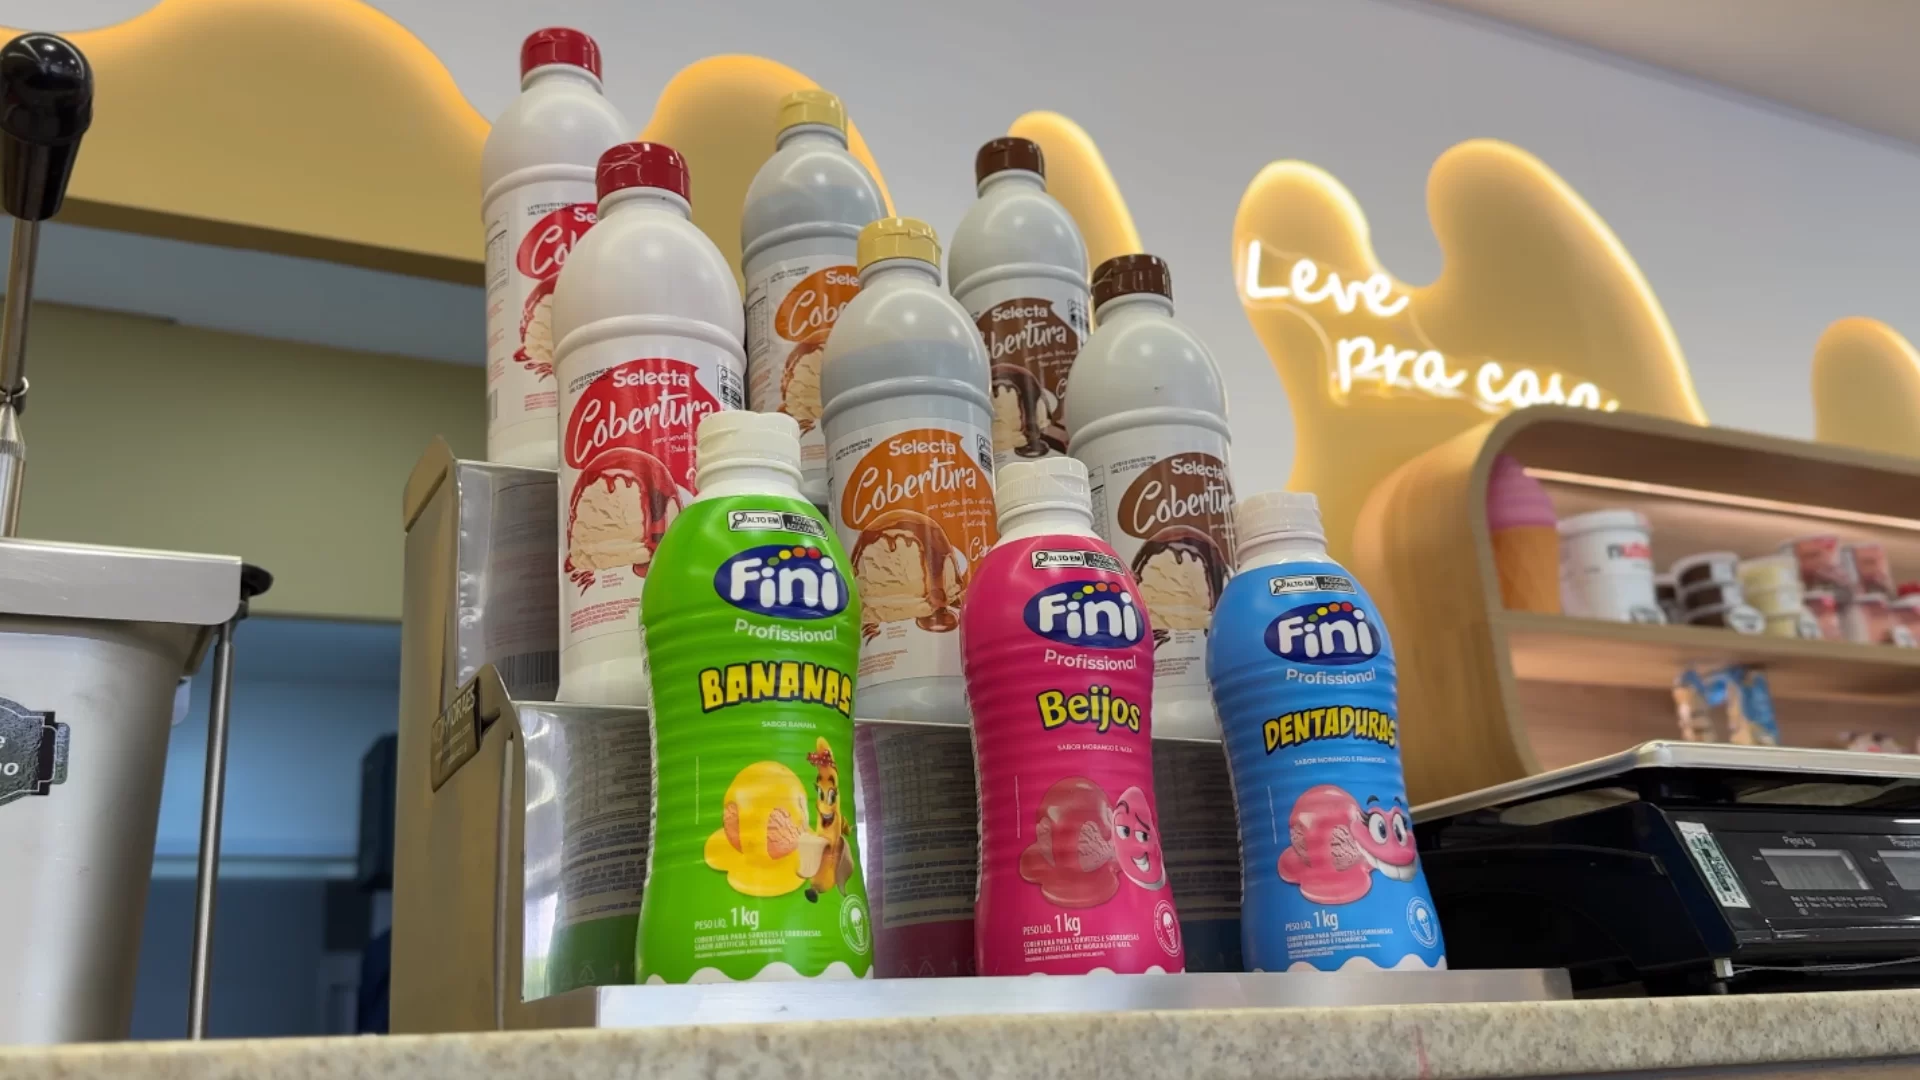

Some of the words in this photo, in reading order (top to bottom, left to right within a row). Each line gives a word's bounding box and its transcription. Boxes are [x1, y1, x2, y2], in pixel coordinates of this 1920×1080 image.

[825, 270, 859, 287] Sele
[1246, 239, 1410, 317] Leve
[991, 304, 1048, 322] Selecta
[980, 319, 1067, 359] bertura
[1336, 335, 1467, 393] pra
[612, 368, 690, 388] Selecta
[889, 438, 956, 456] Selecta
[852, 457, 977, 525] Cobertura
[1133, 480, 1234, 534] Cobertur
[746, 516, 767, 524] ALTO
[768, 516, 780, 524] EM
[1048, 554, 1068, 562] ALTO
[1070, 554, 1081, 562] EM
[730, 556, 839, 611] Fini
[1286, 580, 1304, 588] ALTO
[1304, 579, 1315, 587] EM
[1038, 591, 1138, 642] Fini
[734, 618, 837, 643] Profissional
[1277, 609, 1374, 658] Fini
[1044, 648, 1137, 671] Profissional
[1286, 666, 1376, 685] Profissional
[699, 660, 853, 719] BANANAS
[1036, 683, 1141, 734] Beijos
[761, 720, 787, 728] SABOR
[1263, 705, 1397, 756] DENTADURAS
[1057, 743, 1081, 752] SABOR
[1082, 743, 1115, 752] MORANGO
[1294, 758, 1317, 766] SABOR
[694, 919, 713, 930] PESO
[730, 907, 738, 928] 1
[741, 905, 759, 931] kg
[1023, 926, 1039, 936] PESO
[1054, 914, 1061, 933] 1
[1064, 912, 1081, 937] kg
[1285, 922, 1300, 931] PESO
[1313, 911, 1320, 928] 1
[1321, 909, 1339, 931] kg
[1023, 939, 1055, 949] COBERTURA
[1042, 944, 1074, 953] ARTIFICIAL
